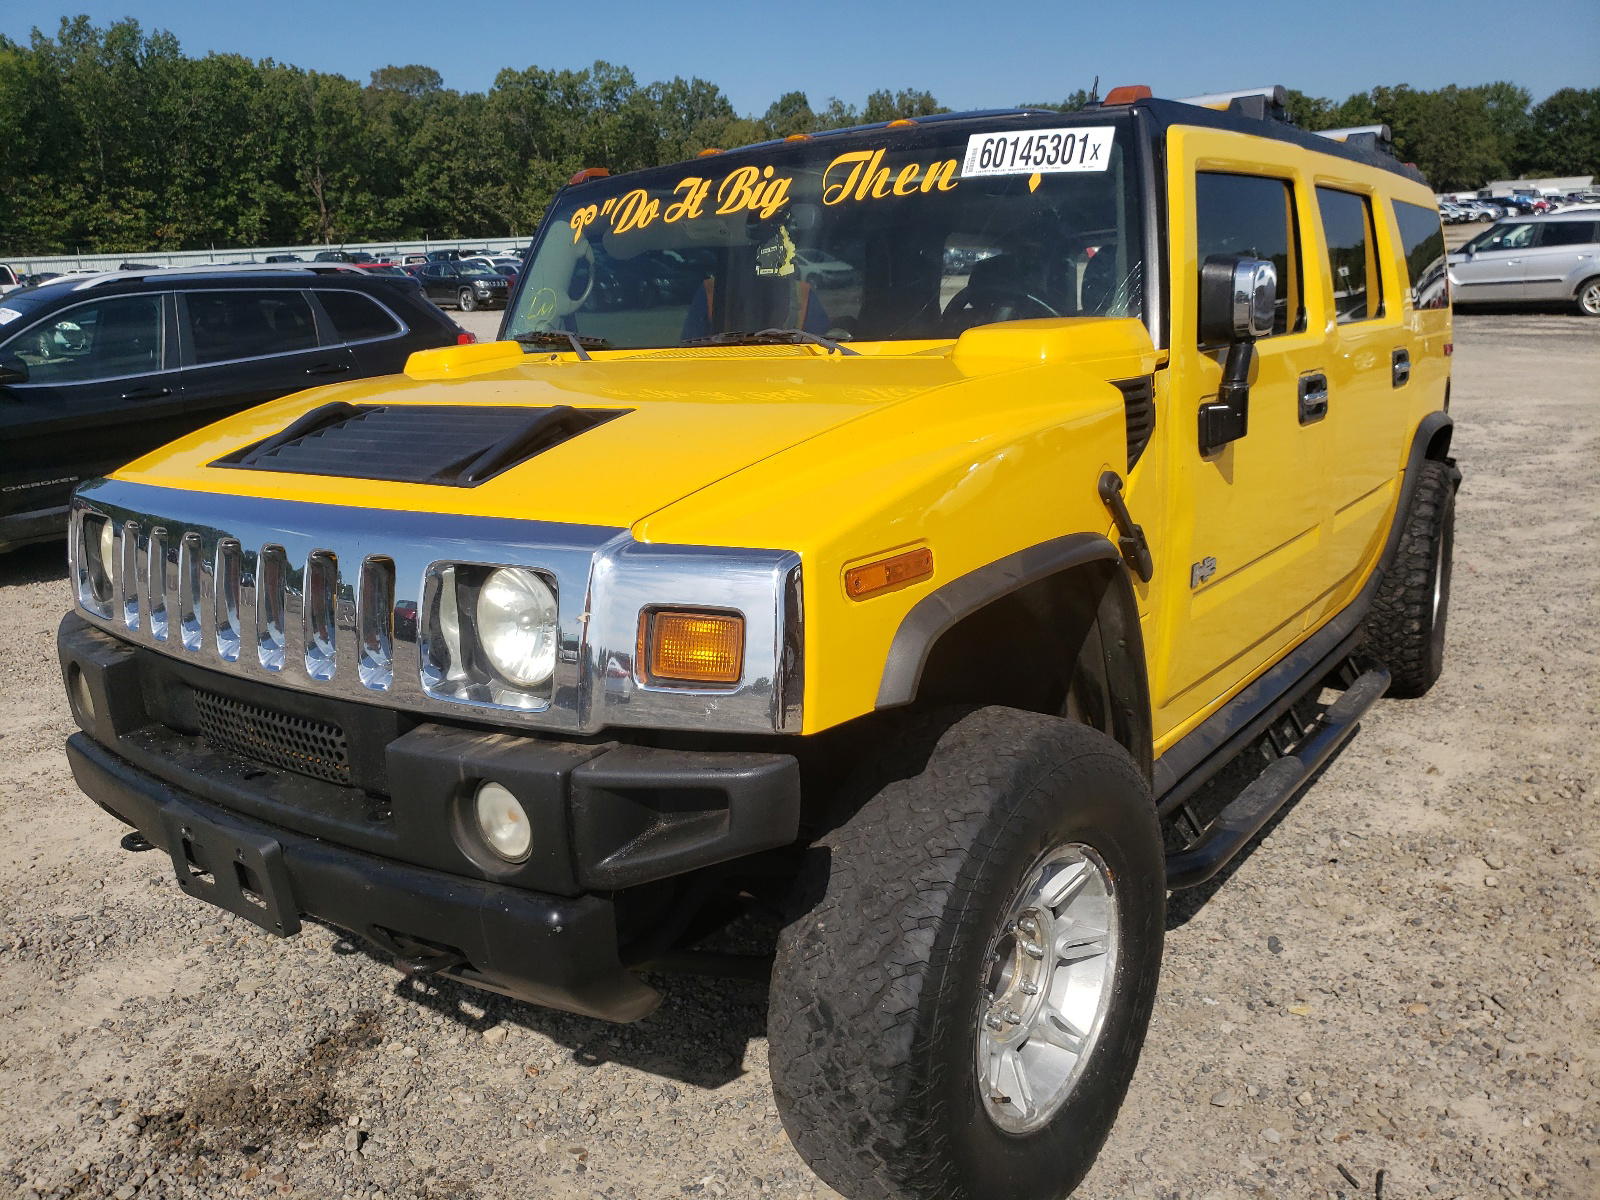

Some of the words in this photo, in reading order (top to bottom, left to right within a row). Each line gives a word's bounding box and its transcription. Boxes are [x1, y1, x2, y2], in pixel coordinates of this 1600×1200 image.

[663, 177, 712, 223] It
[715, 165, 793, 219] Big
[822, 147, 959, 206] Then
